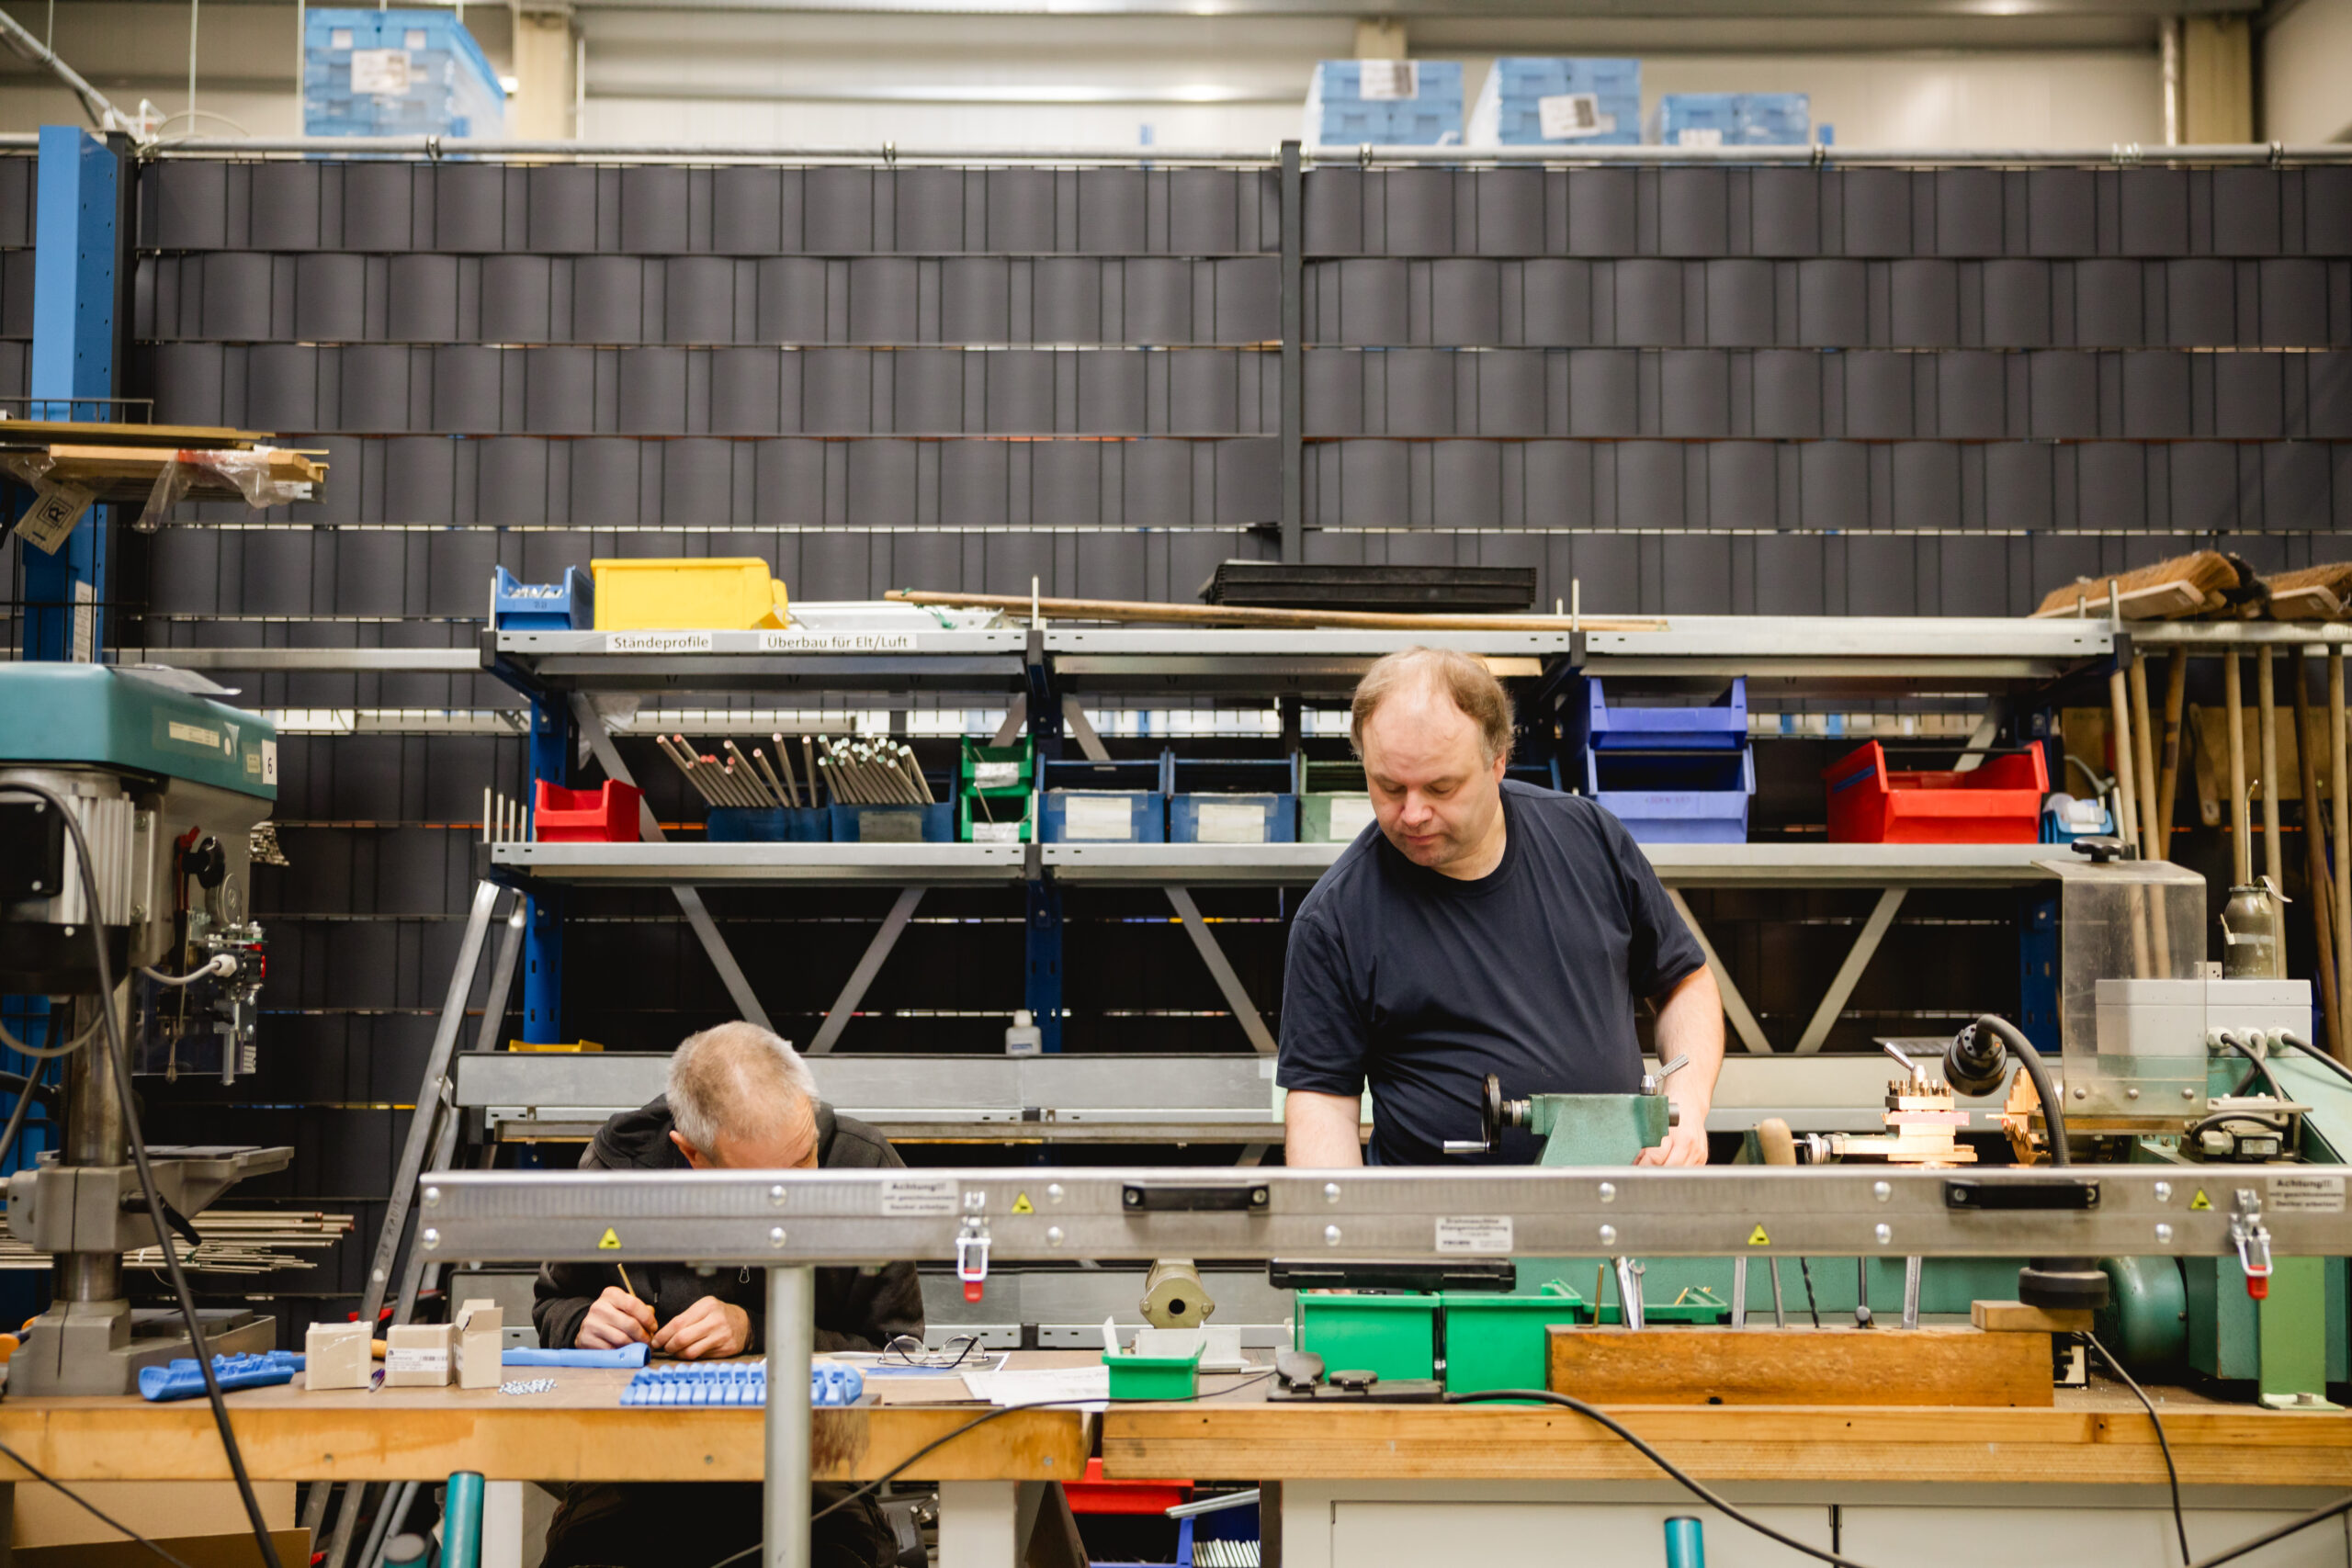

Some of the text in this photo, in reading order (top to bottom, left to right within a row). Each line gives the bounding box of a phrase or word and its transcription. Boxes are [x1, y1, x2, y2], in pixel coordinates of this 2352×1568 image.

[614, 636, 709, 650] Ständeprofile
[767, 633, 908, 650] Überbau für Elt/Luft
[266, 756, 273, 775] 6
